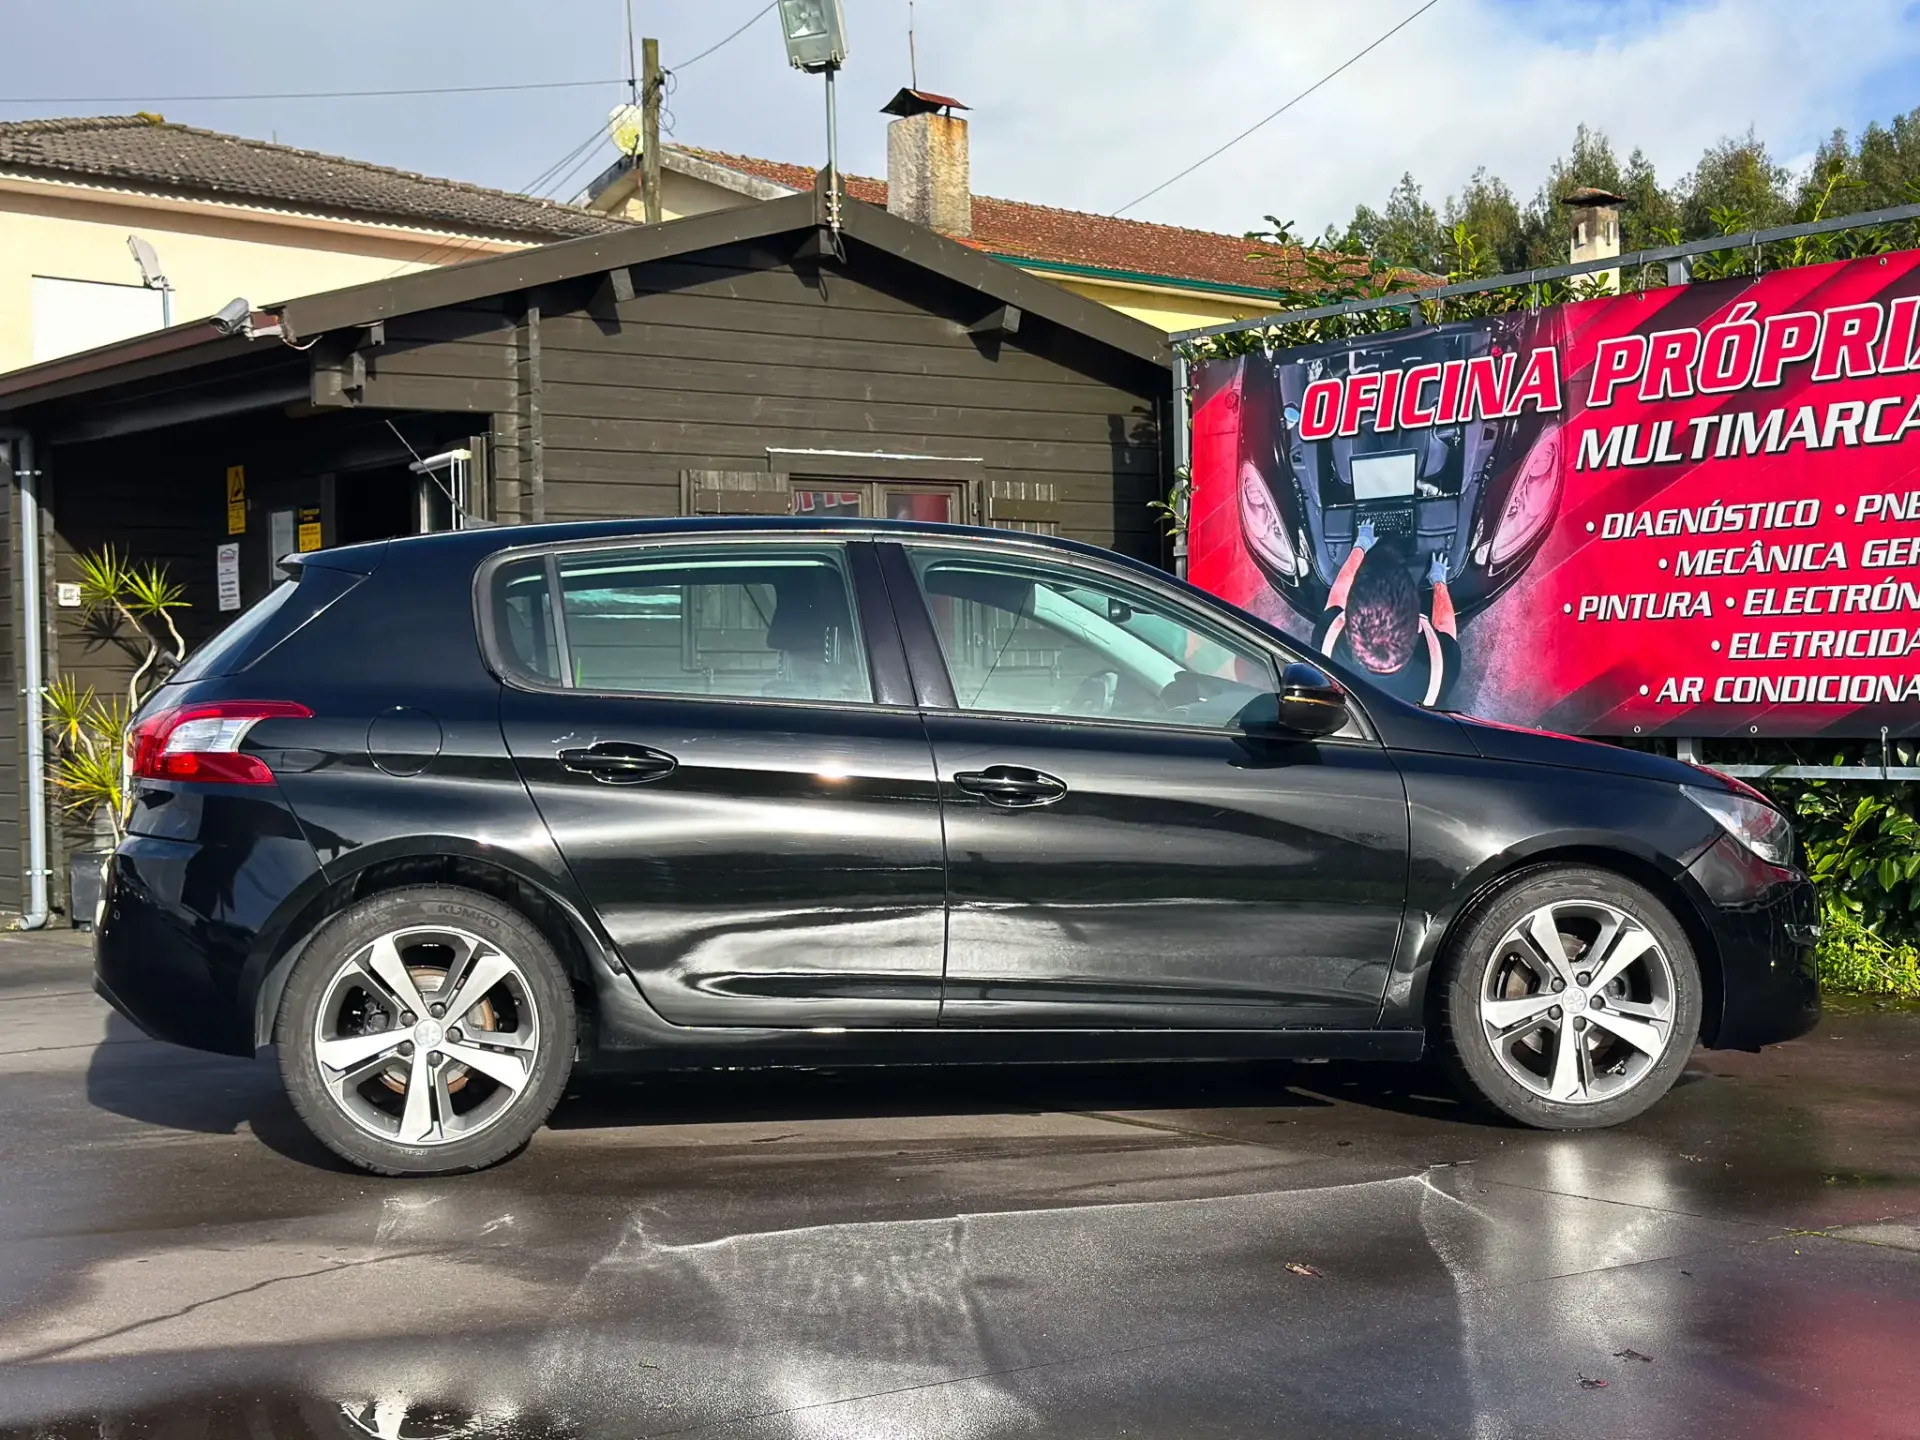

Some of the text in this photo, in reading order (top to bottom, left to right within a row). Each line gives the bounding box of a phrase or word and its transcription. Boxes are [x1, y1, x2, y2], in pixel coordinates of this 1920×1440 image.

[1299, 295, 1920, 440] OFICINA PRÓPRI
[1575, 394, 1920, 470] MULTIMARCA
[1601, 498, 1820, 539] DIAGNÓSTICO
[1675, 540, 1847, 577] MECÂNICA
[1578, 576, 1920, 621] PINTURA ELECTRÓN
[1728, 628, 1920, 659] ELETRICIDA
[1655, 674, 1920, 703] AR CONDICIONA
[438, 904, 500, 929] KUMHO
